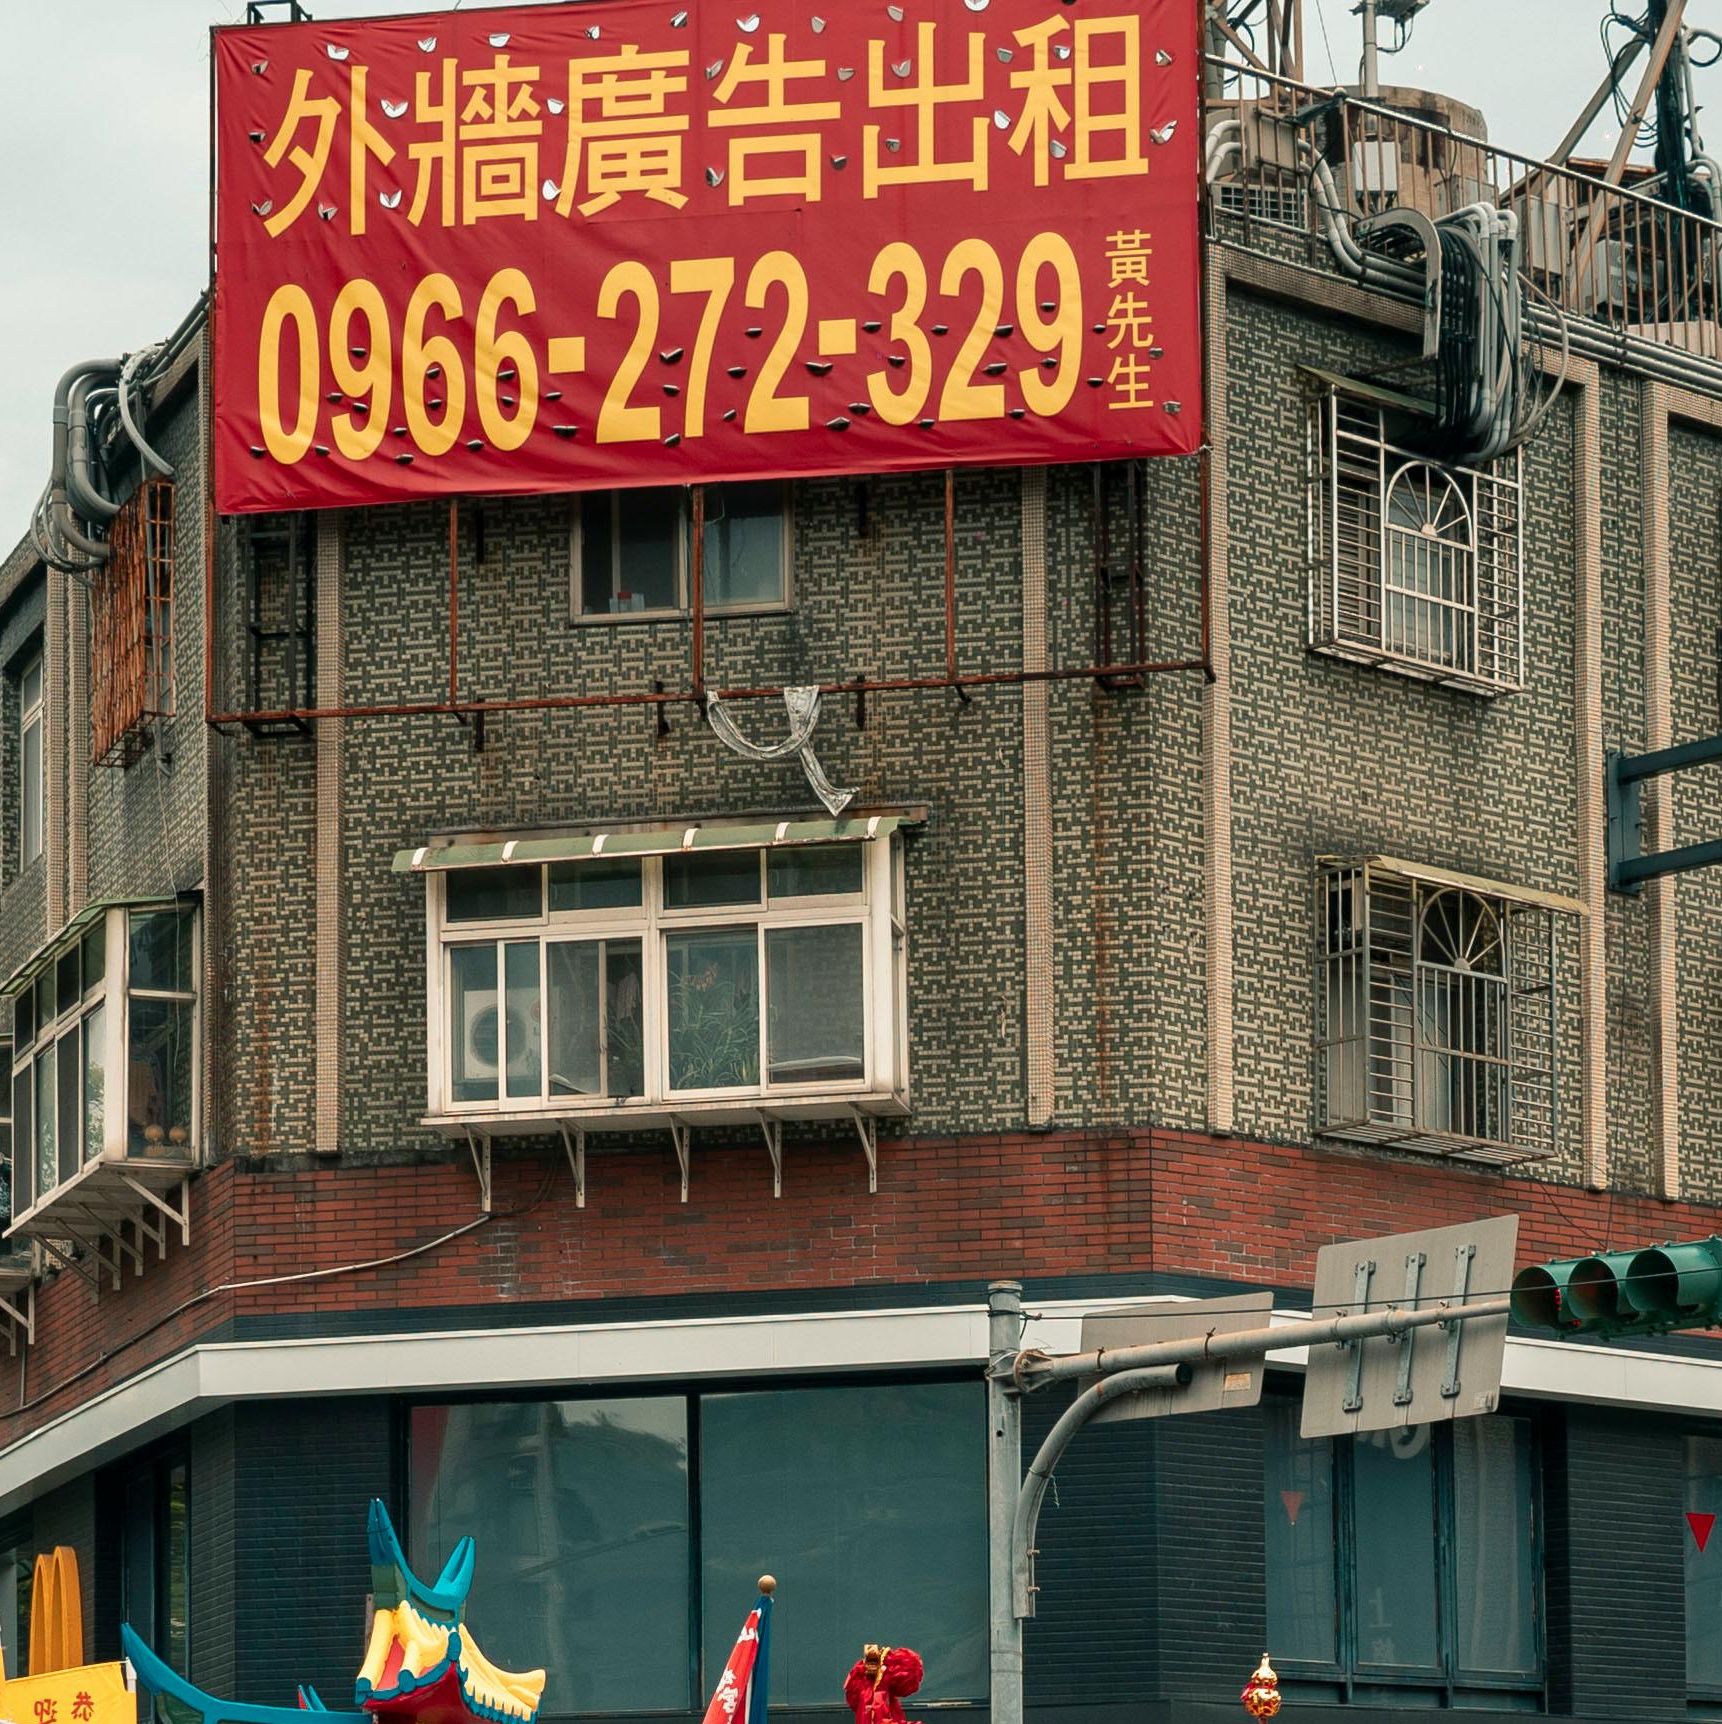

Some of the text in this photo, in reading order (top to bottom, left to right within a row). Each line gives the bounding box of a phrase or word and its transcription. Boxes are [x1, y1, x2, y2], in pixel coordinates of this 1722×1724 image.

[261, 12, 1151, 239] 外牆廣告出租
[257, 231, 1084, 466] 0966-272-329
[1105, 230, 1155, 412] 黃先生
